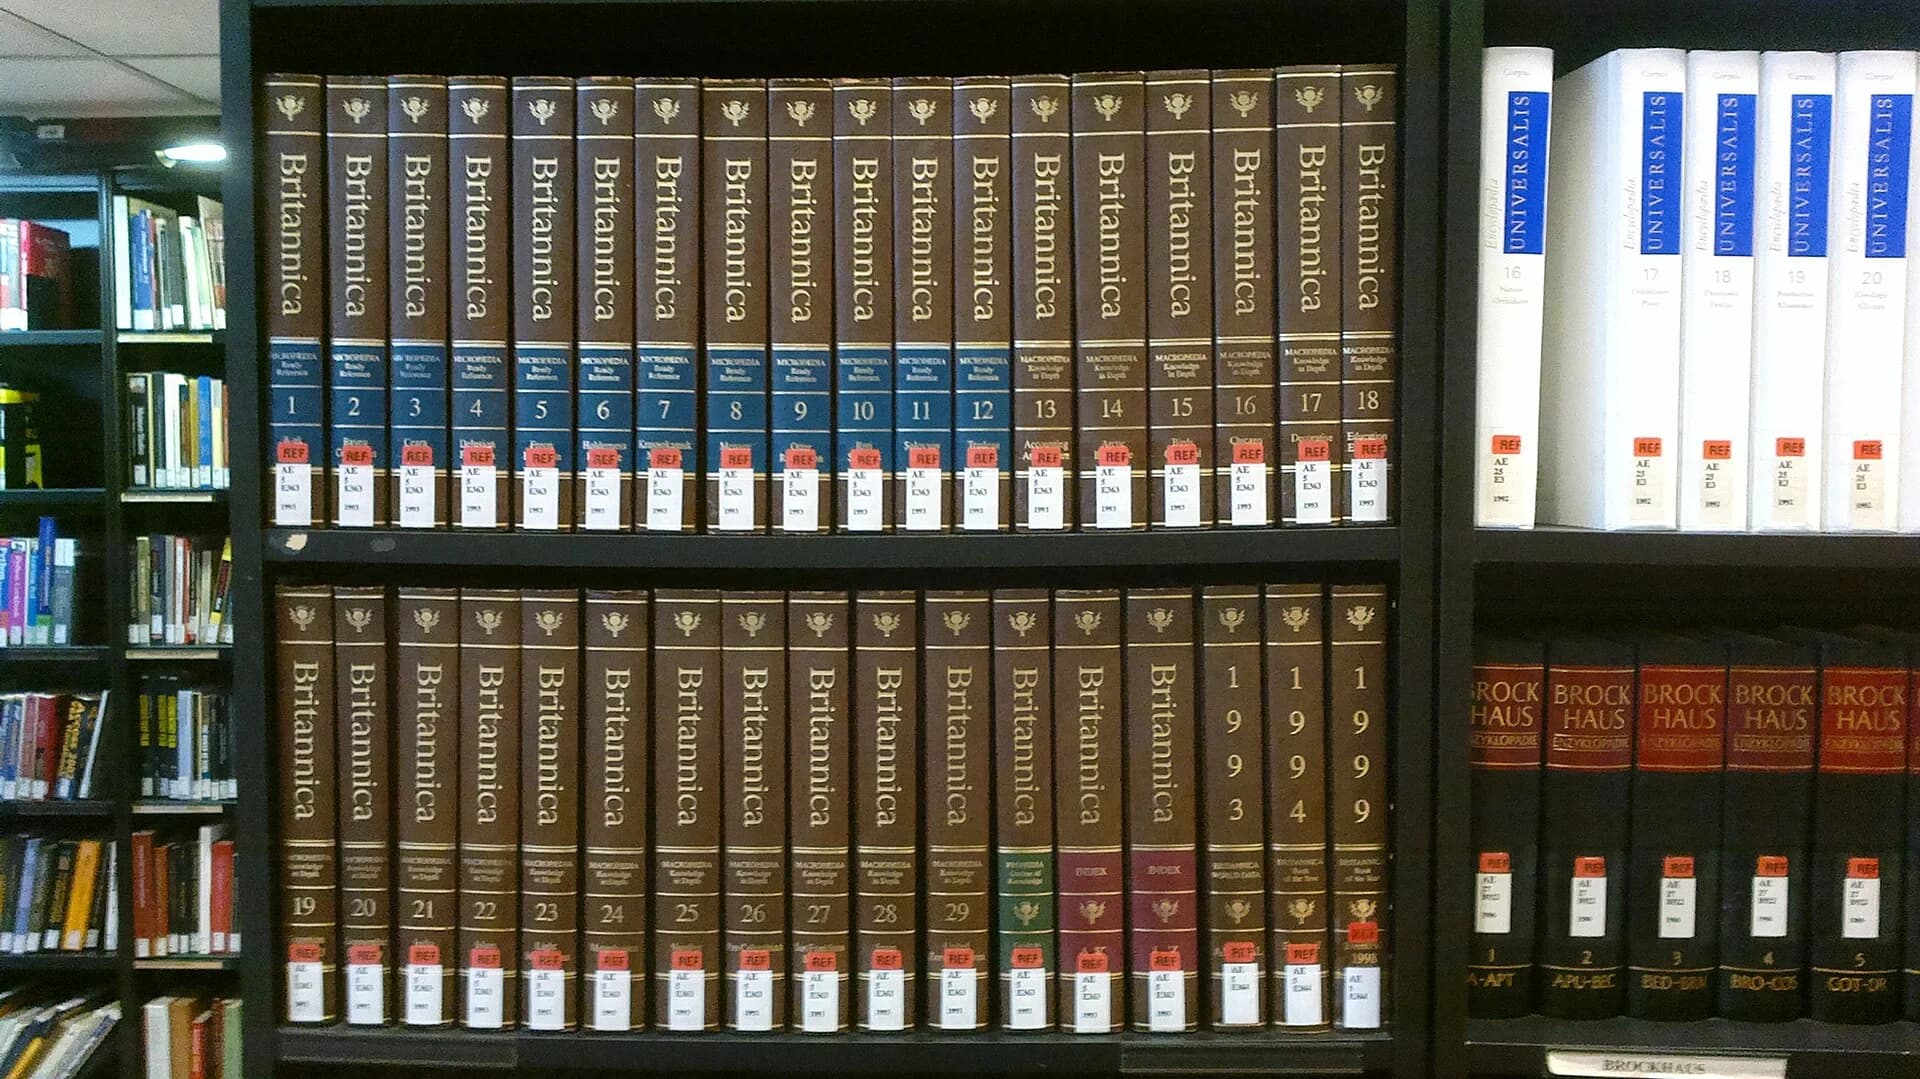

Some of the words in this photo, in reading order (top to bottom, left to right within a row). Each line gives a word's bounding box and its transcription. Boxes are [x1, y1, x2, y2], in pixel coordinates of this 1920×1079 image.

[1511, 96, 1530, 250] UNIVERSALIS
[1648, 96, 1666, 251] UNIVERSALIS
[1721, 98, 1738, 251] UNIVERSALIS
[1795, 98, 1815, 252] UNIVERSALIS
[1872, 98, 1893, 253] UNIVERSALIS
[281, 153, 307, 315] Britannica
[346, 155, 371, 316] Britannica
[405, 155, 431, 318] Britannica
[1035, 153, 1061, 319] Britannica
[1099, 153, 1126, 319] Britannica
[1169, 152, 1196, 317] Britannica
[1235, 149, 1260, 315] Britannica
[1300, 145, 1326, 312] Britannica
[1359, 145, 1385, 310] Britannica
[466, 155, 492, 320] Britannica
[532, 158, 558, 321] Britannica
[595, 157, 620, 321] Britannica
[656, 156, 682, 320] Britannica
[726, 159, 751, 322] Britannica
[792, 159, 816, 323] Britannica
[853, 158, 878, 322] Britannica
[912, 158, 938, 321] Britannica
[974, 157, 999, 321] Britannica
[1504, 266, 1521, 280] 16
[1643, 267, 1658, 282] 17
[1714, 270, 1731, 284] 18
[1788, 270, 1805, 284] 19
[1862, 271, 1882, 285] 20
[289, 396, 295, 414] 1
[349, 397, 359, 415] 2
[410, 398, 420, 416] 3
[470, 399, 482, 417] 4
[659, 400, 670, 418] 7
[1036, 400, 1056, 418] 13
[1102, 399, 1123, 417] 14
[1173, 398, 1192, 416] 15
[1236, 396, 1256, 414] 16
[1302, 393, 1321, 412] 17
[1358, 391, 1378, 409] 18
[535, 401, 547, 419] 5
[597, 401, 609, 419] 6
[731, 402, 741, 420] 8
[795, 402, 807, 421] 9
[854, 402, 873, 420] 10
[913, 402, 929, 420] 11
[973, 401, 993, 419] 12
[283, 448, 305, 458] REF
[1305, 446, 1327, 458] REF
[1362, 444, 1384, 455] REF
[1500, 440, 1520, 450] REF
[1639, 443, 1660, 453] REF
[1709, 446, 1730, 455] REF
[1783, 443, 1804, 453] REF
[1861, 445, 1882, 454] REF
[346, 449, 368, 461] REF
[406, 450, 429, 462] REF
[470, 450, 492, 461] REF
[533, 453, 555, 463] REF
[594, 454, 615, 465] REF
[657, 454, 679, 464] REF
[729, 454, 750, 464] REF
[793, 453, 815, 464] REF
[858, 454, 879, 465] REF
[917, 453, 937, 464] REF
[974, 453, 994, 464] REF
[1038, 453, 1060, 464] REF
[1106, 452, 1128, 464] REF
[1174, 450, 1196, 461] REF
[1241, 450, 1261, 459] REF
[1494, 458, 1509, 466] AE
[1236, 466, 1250, 474] AE
[1359, 461, 1373, 470] AE
[1472, 681, 1539, 702] ROCK
[1554, 684, 1631, 705] BROCK
[1645, 684, 1722, 705] BROCK
[1736, 685, 1814, 705] BROCK
[1828, 685, 1904, 706] BROCK
[1472, 706, 1533, 727] HAUS
[1564, 709, 1625, 729] HAUS
[1653, 707, 1717, 729] HAUS
[1745, 709, 1808, 730] HAUS
[1837, 710, 1900, 730] HAUS
[294, 662, 320, 819] Britannica
[351, 664, 377, 820] Britannica
[416, 664, 442, 822] Britannica
[478, 665, 504, 822] Britannica
[538, 666, 564, 825] Britannica
[605, 668, 630, 826] Britannica
[678, 668, 703, 825] Britannica
[743, 667, 768, 827] Britannica
[810, 668, 835, 827] Britannica
[877, 668, 902, 827] Britannica
[947, 666, 972, 825] Britannica
[1014, 668, 1039, 824] Britannica
[1079, 667, 1104, 824] Britannica
[1151, 664, 1177, 822] Britannica
[1228, 666, 1244, 821] 1993
[1290, 667, 1306, 823] 1994
[1354, 666, 1371, 823] 1999
[293, 897, 315, 915] 19
[351, 899, 376, 917] 20
[413, 900, 432, 918] 21
[474, 902, 496, 919] 22
[535, 903, 557, 921] 23
[600, 904, 623, 922] 24
[676, 904, 698, 922] 25
[740, 904, 765, 922] 26
[808, 905, 830, 922] 27
[873, 904, 897, 923] 28
[945, 903, 969, 921] 29
[296, 949, 317, 958] REF
[357, 951, 376, 959] REF
[415, 951, 436, 961] REF
[477, 955, 498, 964] REF
[539, 956, 561, 966] REF
[604, 956, 625, 965] REF
[679, 956, 699, 965] REF
[745, 956, 767, 965] REF
[812, 956, 832, 967] REF
[876, 955, 897, 964] REF
[949, 953, 970, 963] REF
[1017, 953, 1040, 964] REF
[1155, 956, 1177, 966] REF
[1232, 948, 1254, 957] REF
[1293, 950, 1317, 959] REF
[1488, 948, 1495, 962] 1
[1582, 951, 1593, 965] 2
[1673, 952, 1682, 966] 3
[1763, 952, 1774, 965] 4
[1855, 953, 1866, 967] 5
[1082, 959, 1104, 969] REF
[1603, 1060, 1705, 1074] BROCKHAUS
